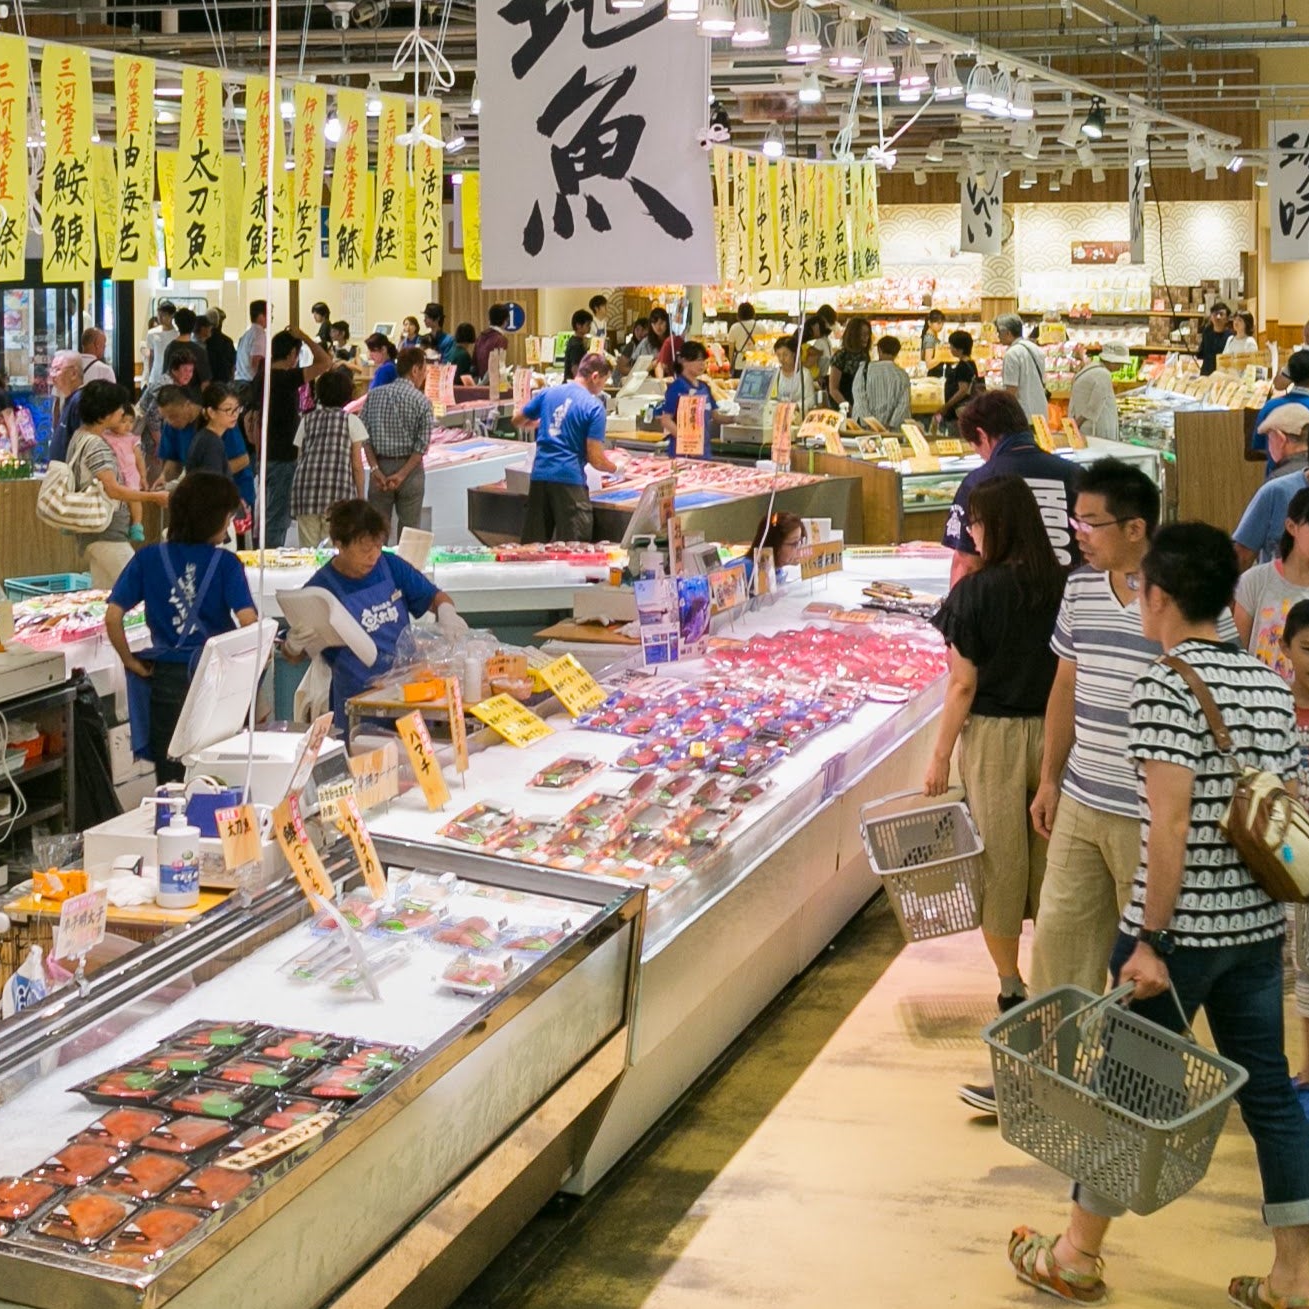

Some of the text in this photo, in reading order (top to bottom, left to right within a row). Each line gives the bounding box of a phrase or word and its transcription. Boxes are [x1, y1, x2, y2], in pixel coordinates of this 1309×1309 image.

[178, 139, 220, 271] 太刀魚
[410, 731, 430, 774] ハマチ
[347, 815, 375, 875] ひらめ
